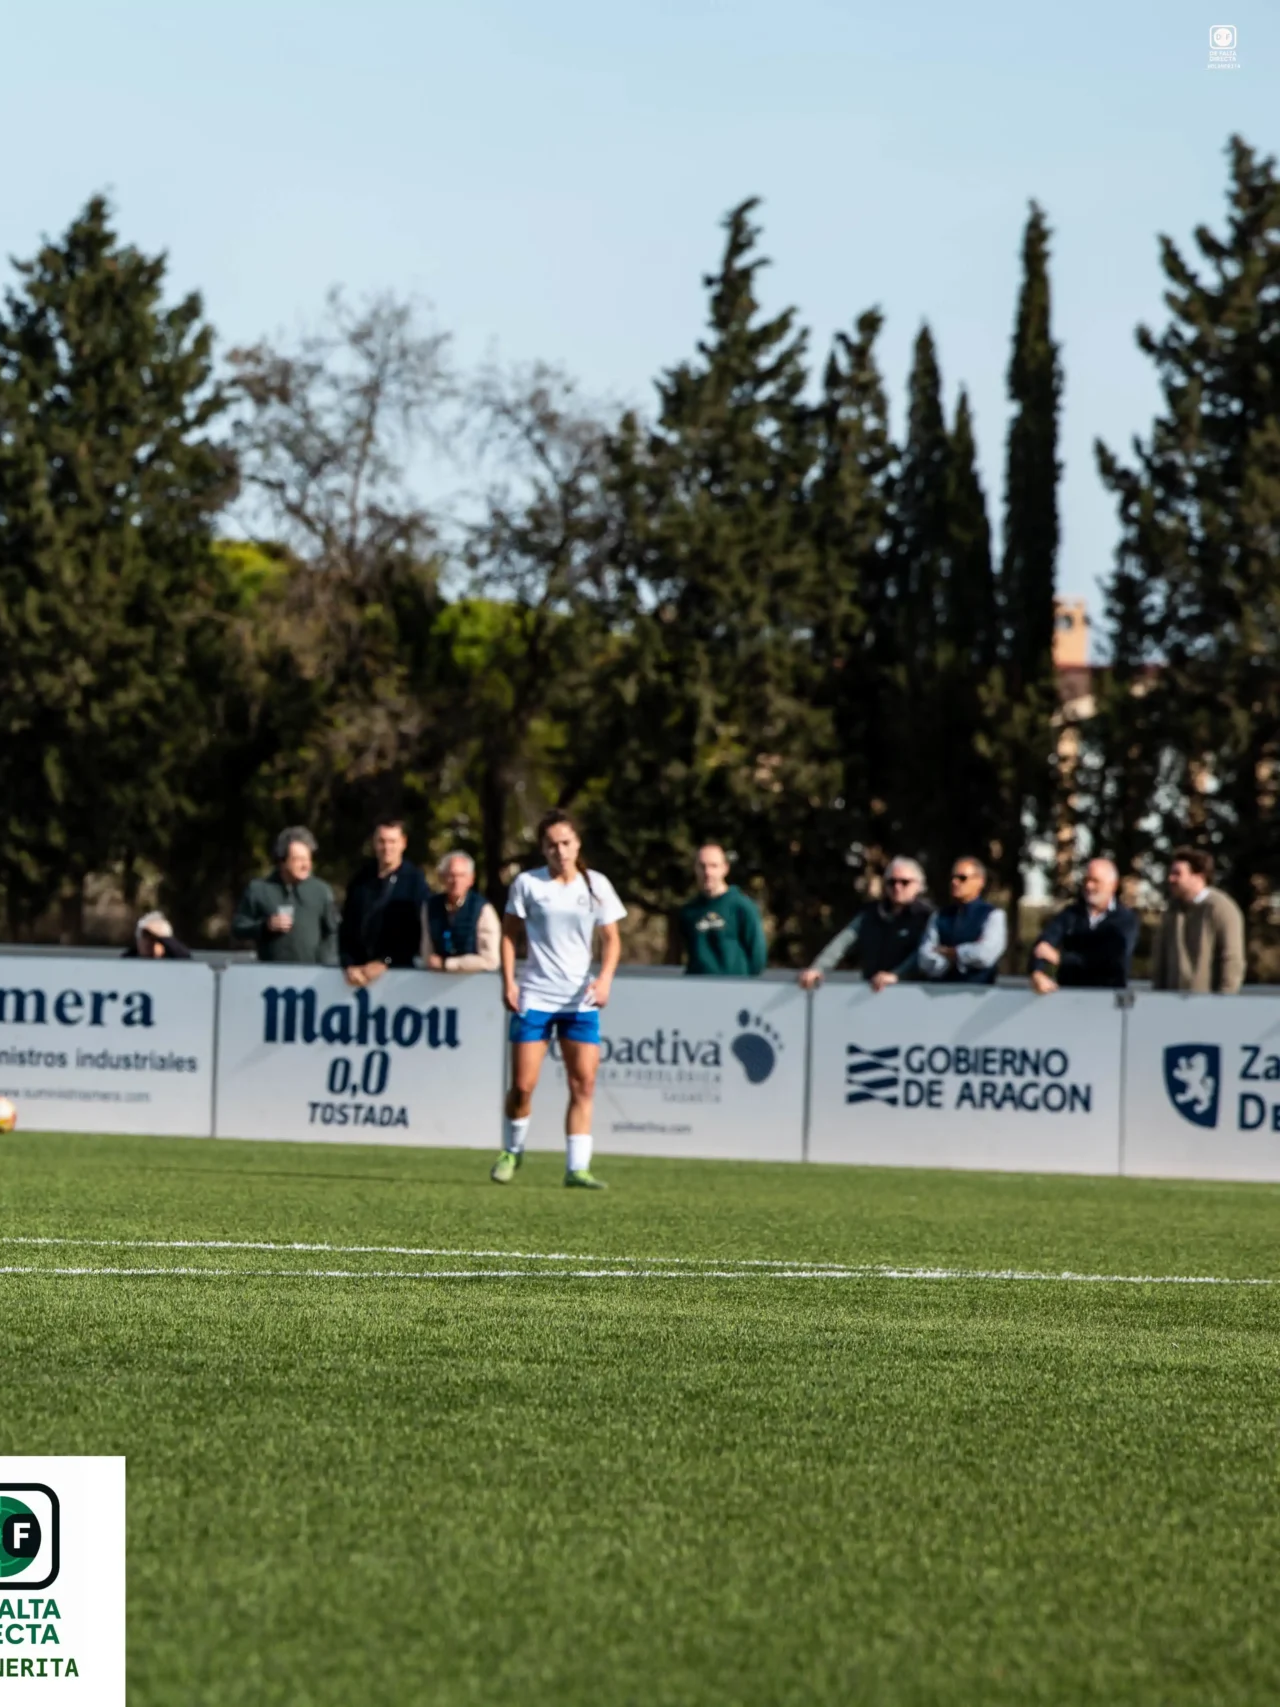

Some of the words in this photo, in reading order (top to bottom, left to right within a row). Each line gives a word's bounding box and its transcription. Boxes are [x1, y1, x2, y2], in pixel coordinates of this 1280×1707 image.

[261, 986, 461, 1050] Mahou
[75, 1048, 198, 1073] industriales
[327, 1049, 392, 1100] 0,0
[904, 1045, 1070, 1078] GOBIERNO
[902, 1079, 944, 1109] DE
[955, 1081, 1093, 1114] ARAGON
[308, 1102, 410, 1129] TOSTADA
